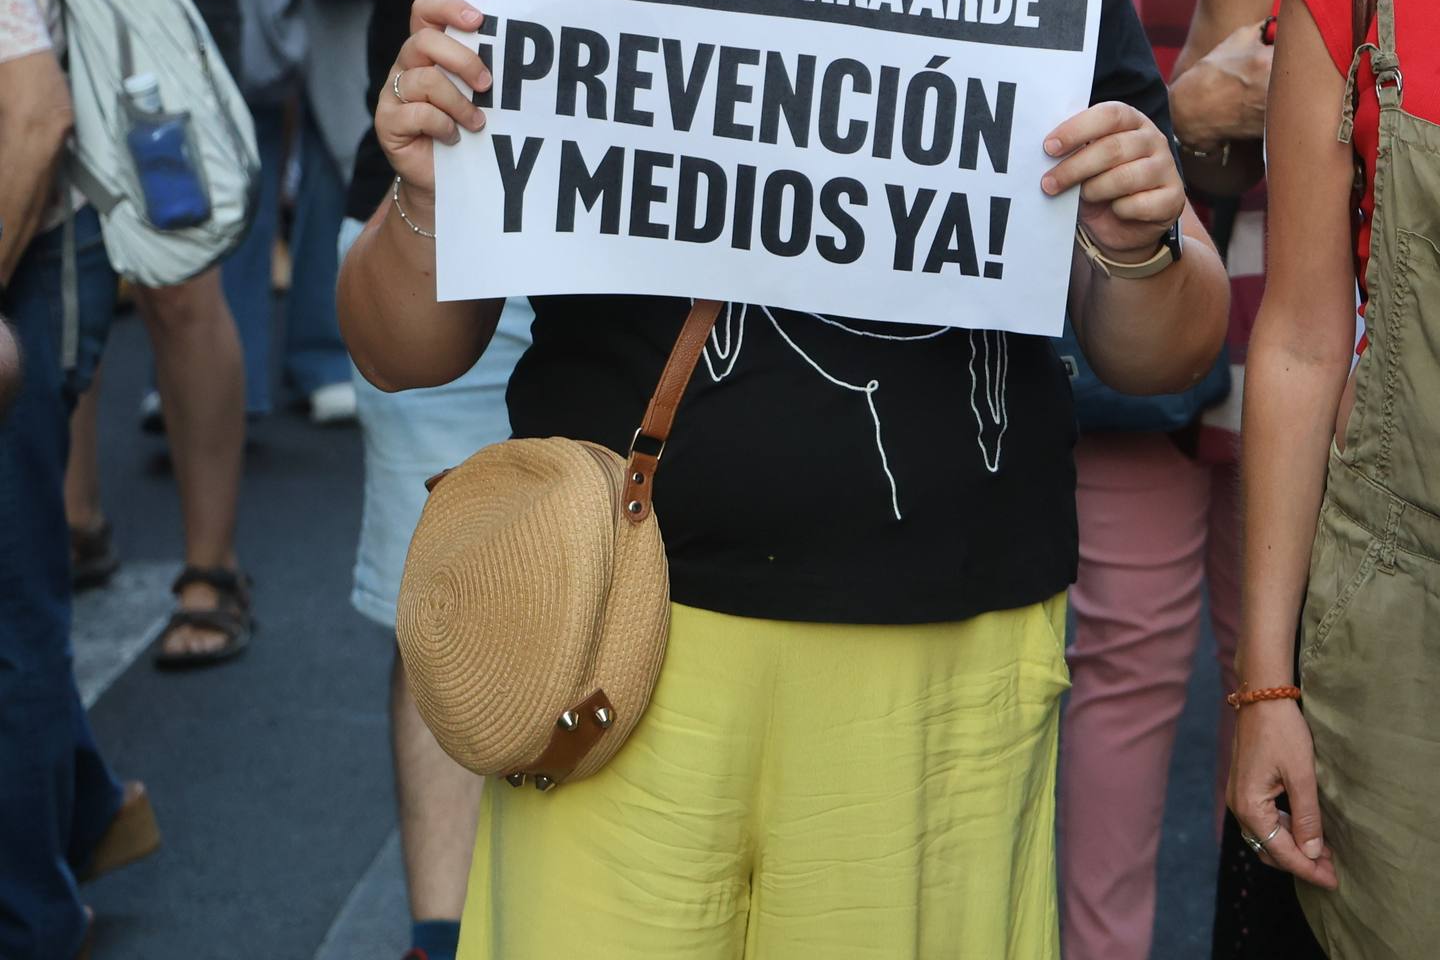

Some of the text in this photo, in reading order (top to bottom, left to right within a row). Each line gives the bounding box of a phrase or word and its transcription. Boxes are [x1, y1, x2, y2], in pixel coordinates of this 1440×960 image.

[492, 134, 1012, 280] Y MEDIOS YA!
